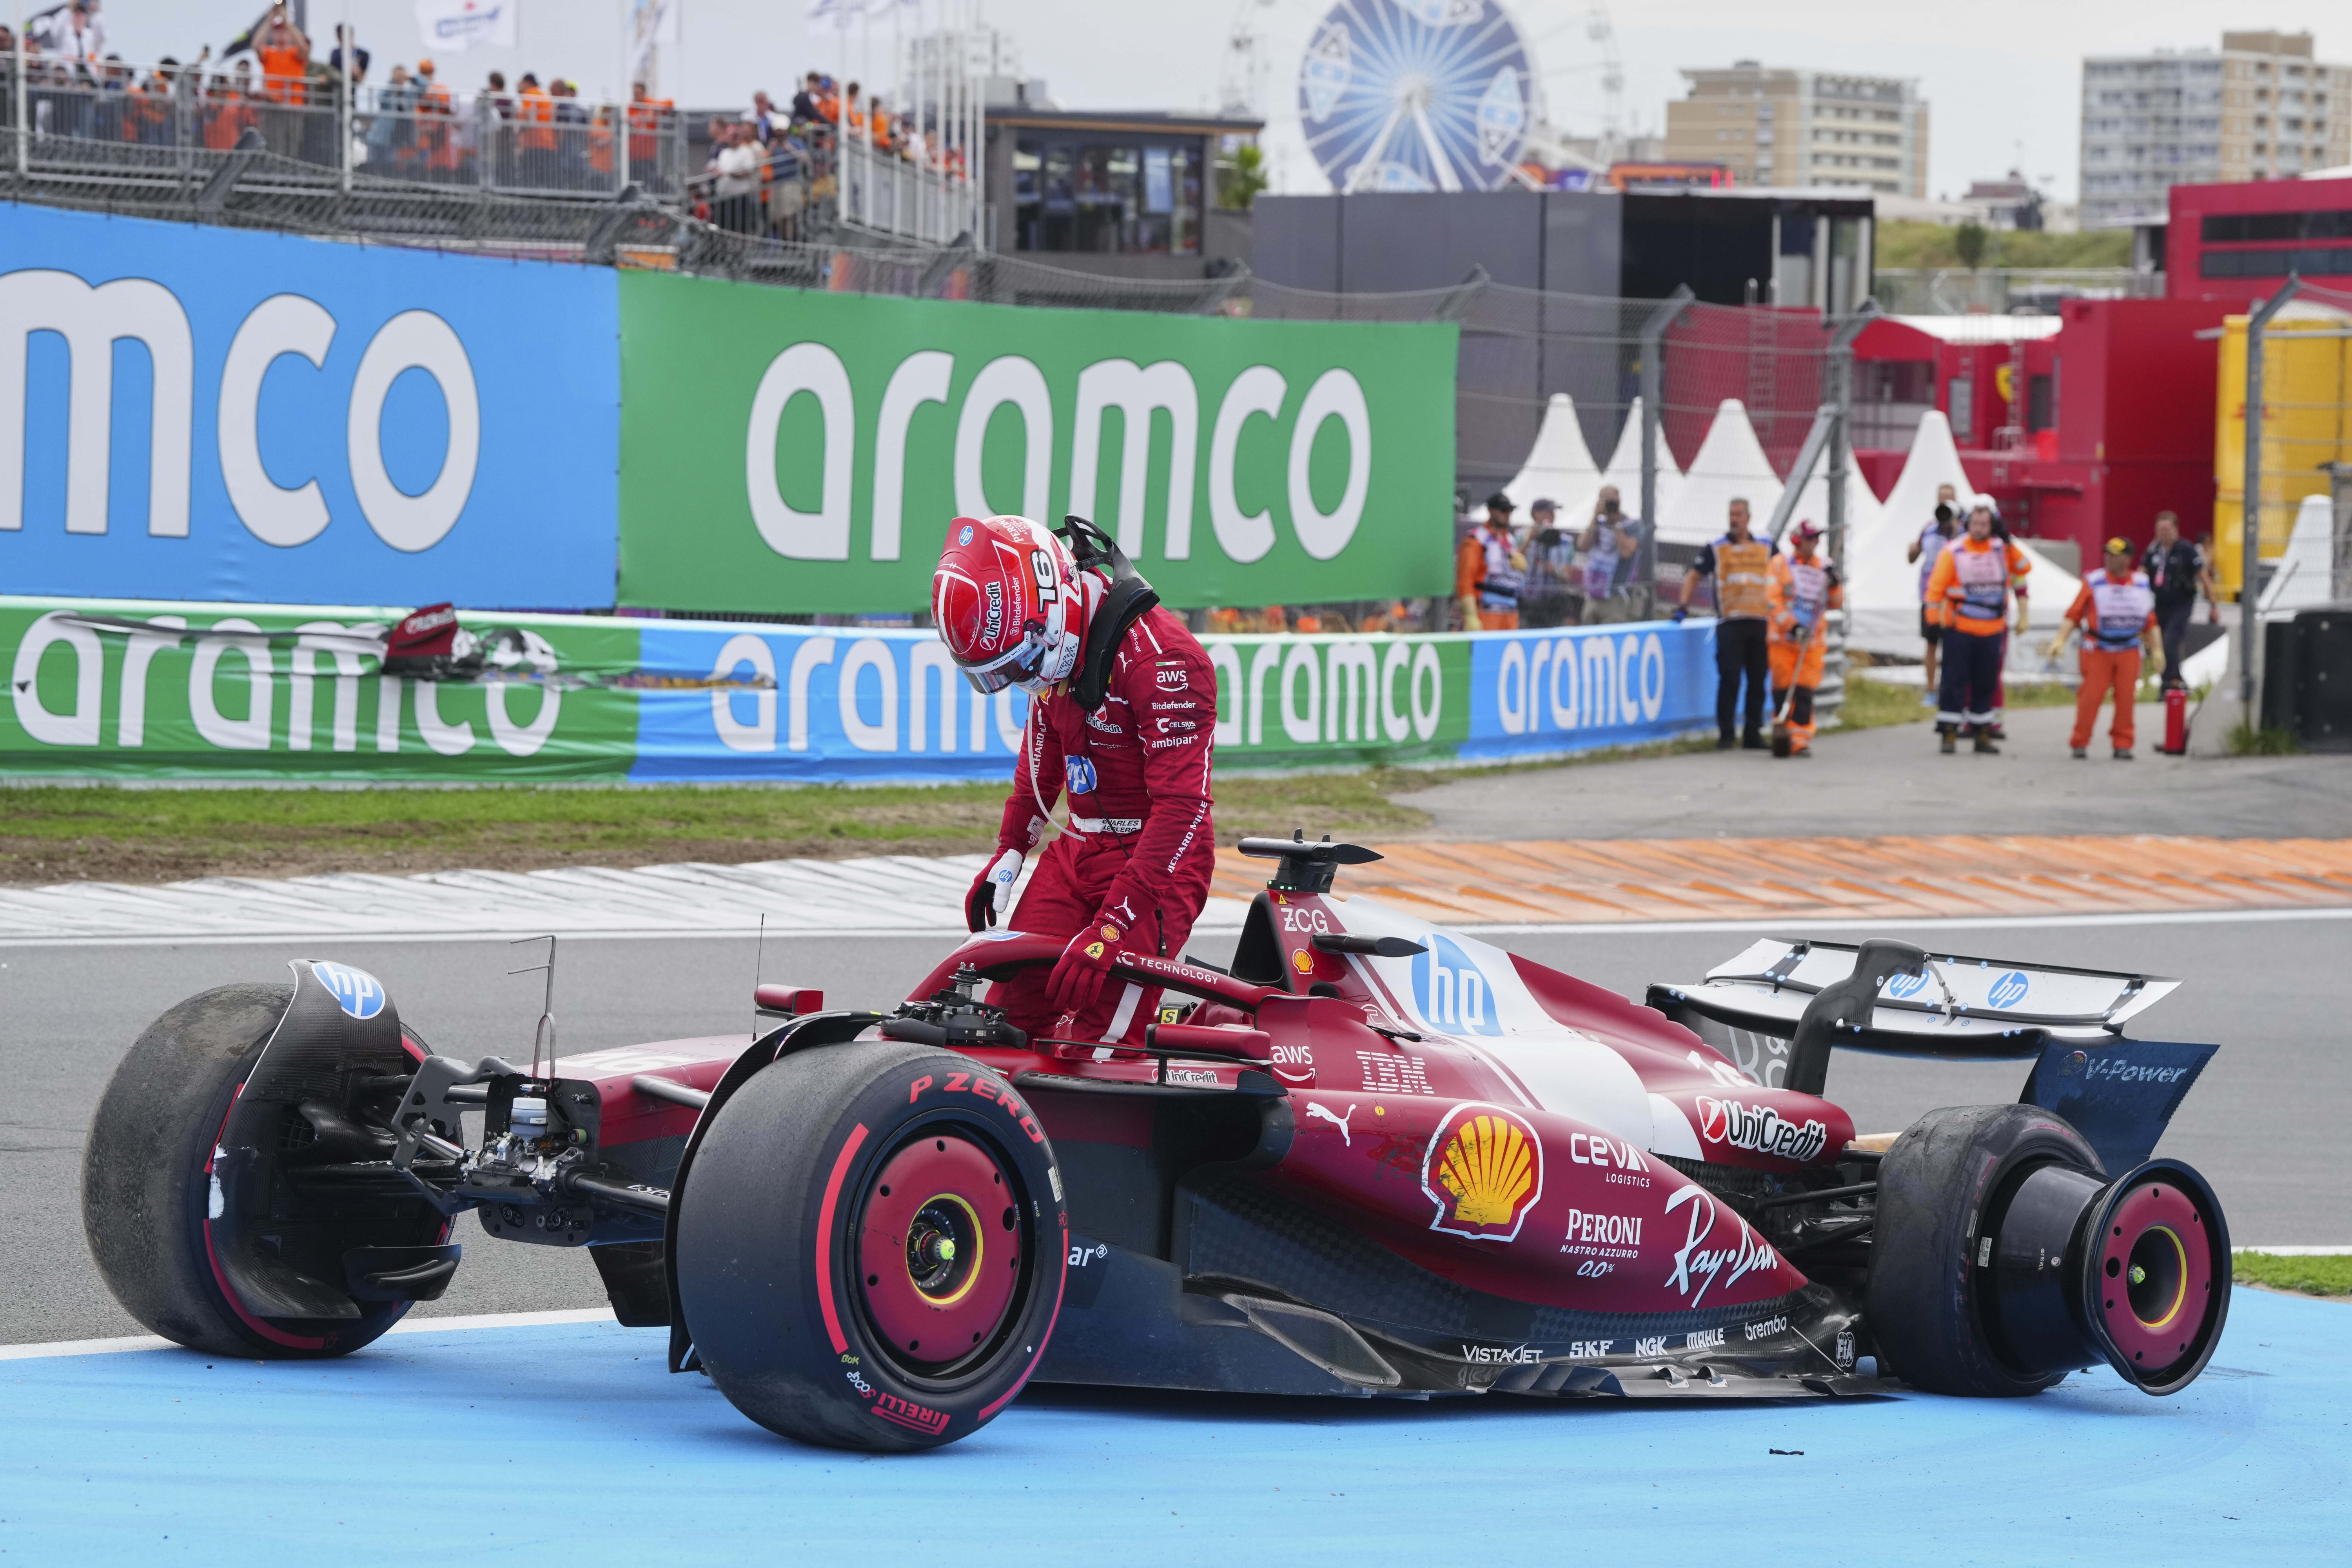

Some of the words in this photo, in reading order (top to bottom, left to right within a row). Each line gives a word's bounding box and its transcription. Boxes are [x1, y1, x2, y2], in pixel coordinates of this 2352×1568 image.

[746, 341, 1371, 564] aramco
[960, 526, 973, 546] hp
[996, 519, 1024, 542] PERONI
[1030, 548, 1058, 614] 16
[985, 581, 1002, 639] UniCredit
[1013, 576, 1021, 626] Bitdefender
[1128, 627, 1142, 652] HNOLOGY
[993, 655, 1011, 666] RICHARD
[1011, 646, 1024, 656] MILLE
[1056, 643, 1077, 675] IBM
[1156, 670, 1187, 682] aws
[1498, 632, 1664, 736] aramco
[712, 633, 1029, 755] aram
[1151, 701, 1196, 710] Bitdefender
[1207, 641, 1442, 746] aramco
[1086, 711, 1122, 733] UniCredit
[1151, 736, 1193, 748] ambipar
[1190, 801, 1208, 830] MILLE
[998, 869, 1013, 883] hp
[1281, 908, 1329, 933] ZCG
[1116, 950, 1136, 966] XC
[1140, 957, 1218, 984] TECHNOLOGY
[321, 962, 376, 1018] hp
[1422, 934, 1488, 1036] hp
[1989, 972, 2027, 1008] hp
[1163, 1011, 1175, 1024] S
[1271, 1045, 1313, 1064] aws
[1166, 1070, 1218, 1083] UniCredit
[1356, 1051, 1434, 1094] IBM
[2085, 1059, 2188, 1083] V-Power
[909, 1075, 933, 1104] P
[944, 1073, 1044, 1143] ZERO
[1724, 1100, 1826, 1161] UniCredit
[1606, 1173, 1650, 1188] LOGISTICS
[1566, 1209, 1642, 1245] PERONI
[1560, 1245, 1597, 1256] NASTRO
[1599, 1248, 1638, 1258] AZZURRO
[1577, 1261, 1615, 1278] 0.0%
[1686, 1328, 1725, 1350] MAHLE
[1744, 1315, 1787, 1341] brembo
[1570, 1341, 1613, 1358] SKF
[1635, 1336, 1668, 1357] NGK
[871, 1392, 951, 1436] PIRELLI
